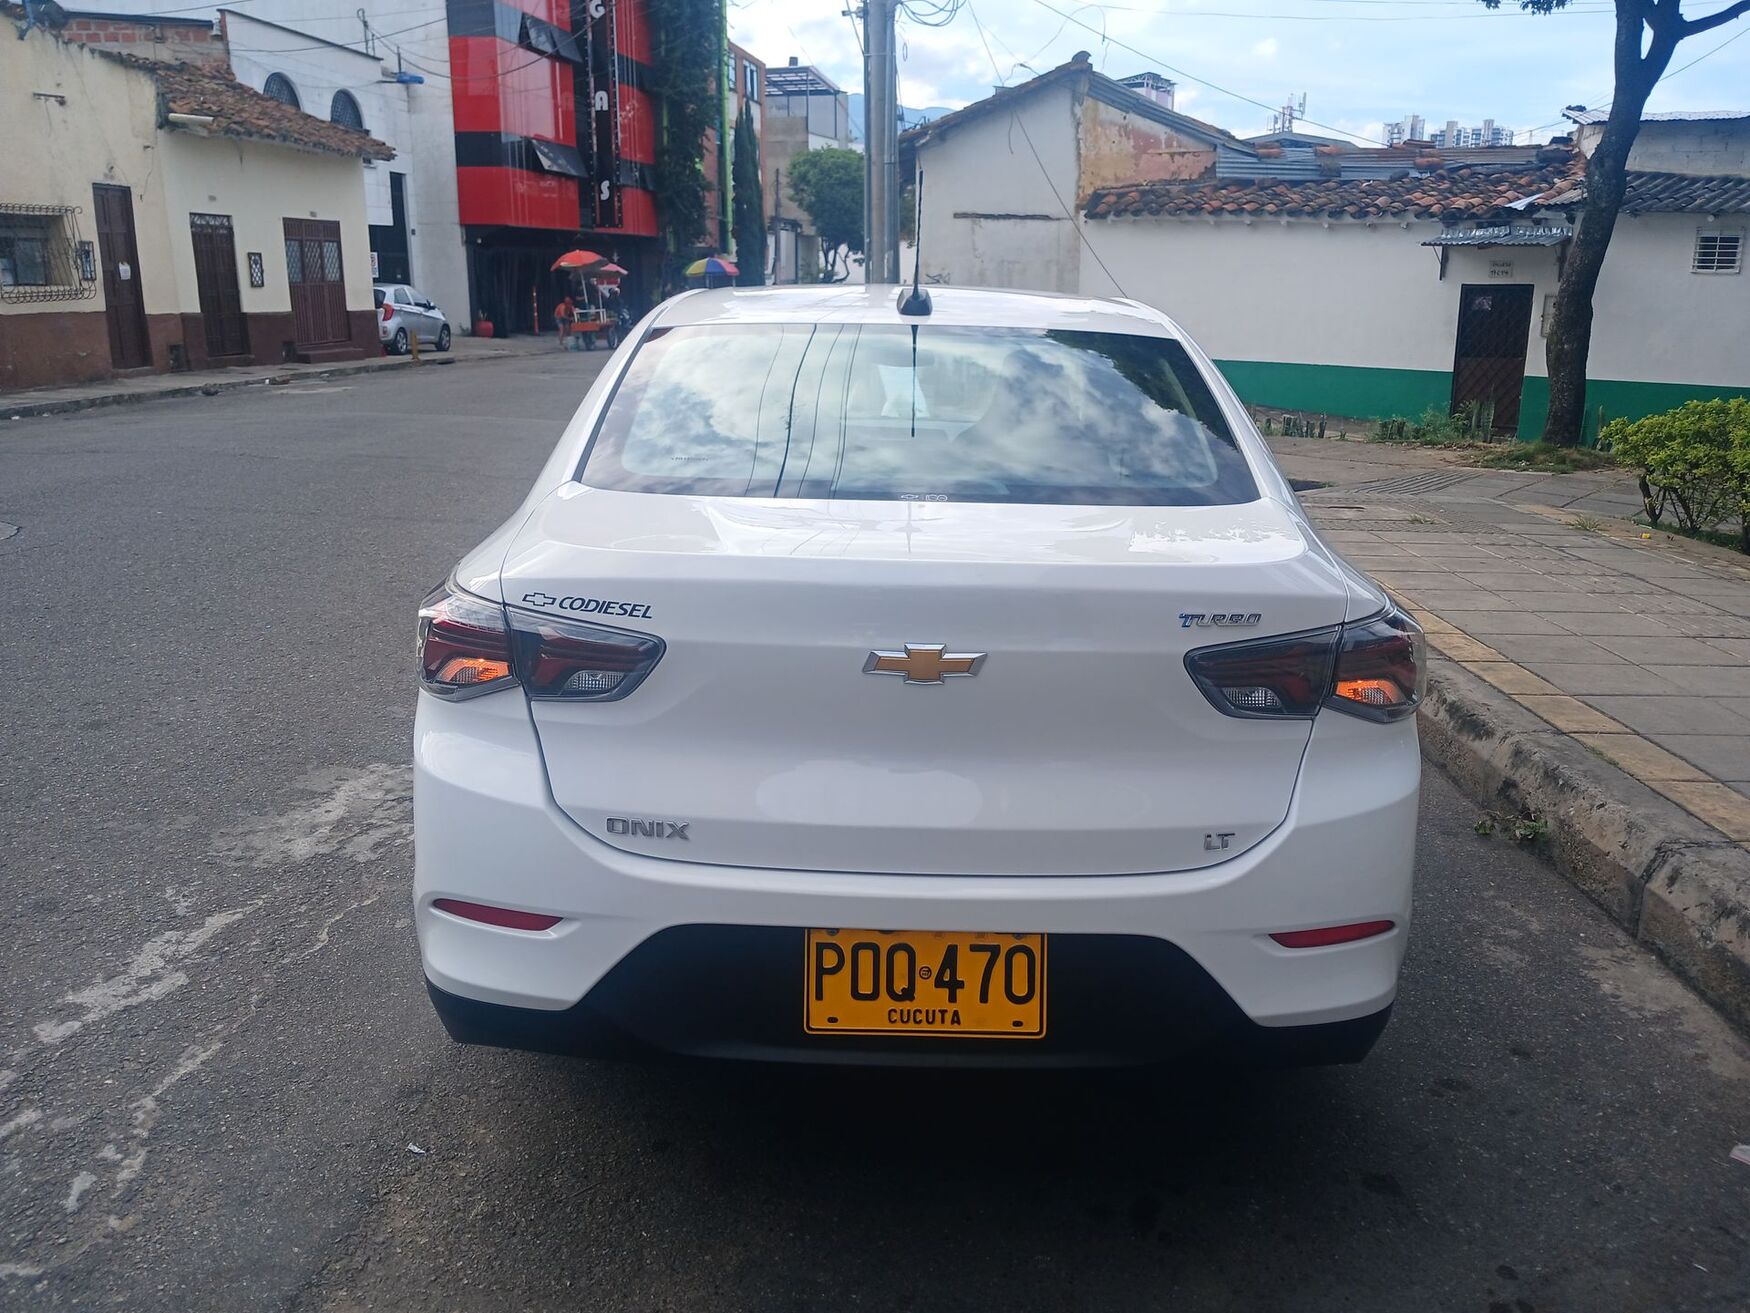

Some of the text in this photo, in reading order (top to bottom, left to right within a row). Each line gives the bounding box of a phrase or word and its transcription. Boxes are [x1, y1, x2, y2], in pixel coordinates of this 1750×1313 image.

[558, 596, 653, 619] CODIESEL
[1179, 613, 1262, 628] TURBO
[606, 816, 690, 840] ONIX
[1204, 832, 1236, 851] LT
[934, 944, 1035, 1005] 470
[887, 1008, 961, 1026] CUCUTA
